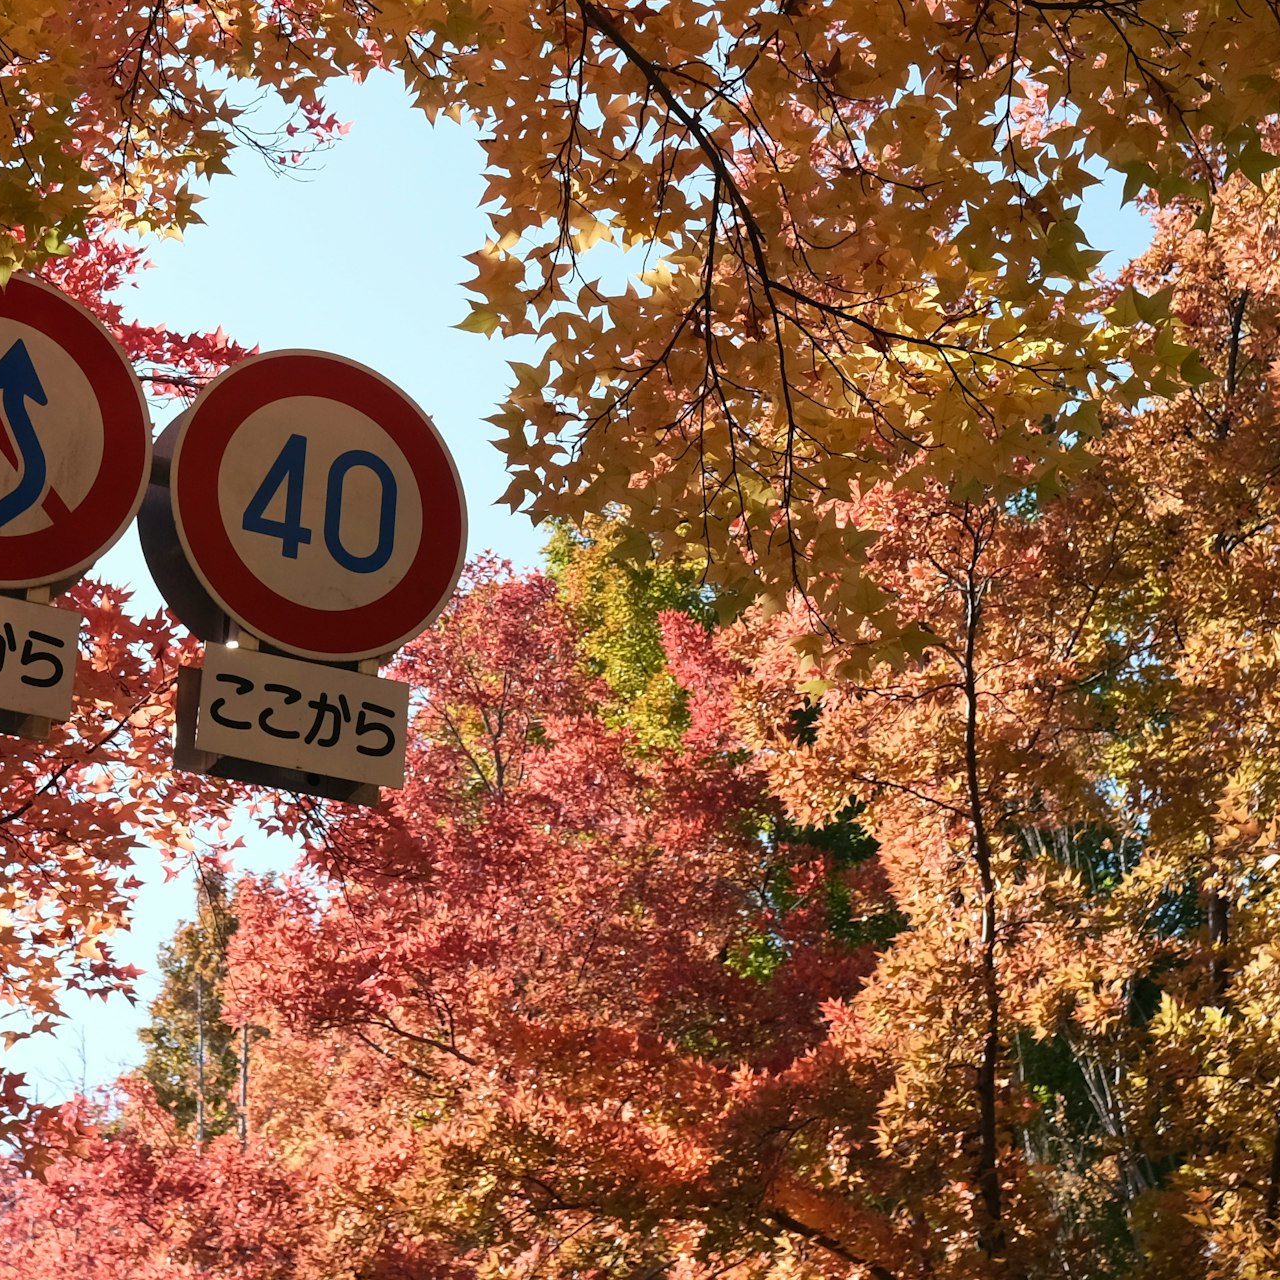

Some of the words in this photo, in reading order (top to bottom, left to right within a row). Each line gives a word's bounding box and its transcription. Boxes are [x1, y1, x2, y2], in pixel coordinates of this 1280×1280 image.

[242, 433, 397, 573] 40
[210, 673, 396, 757] ここから
